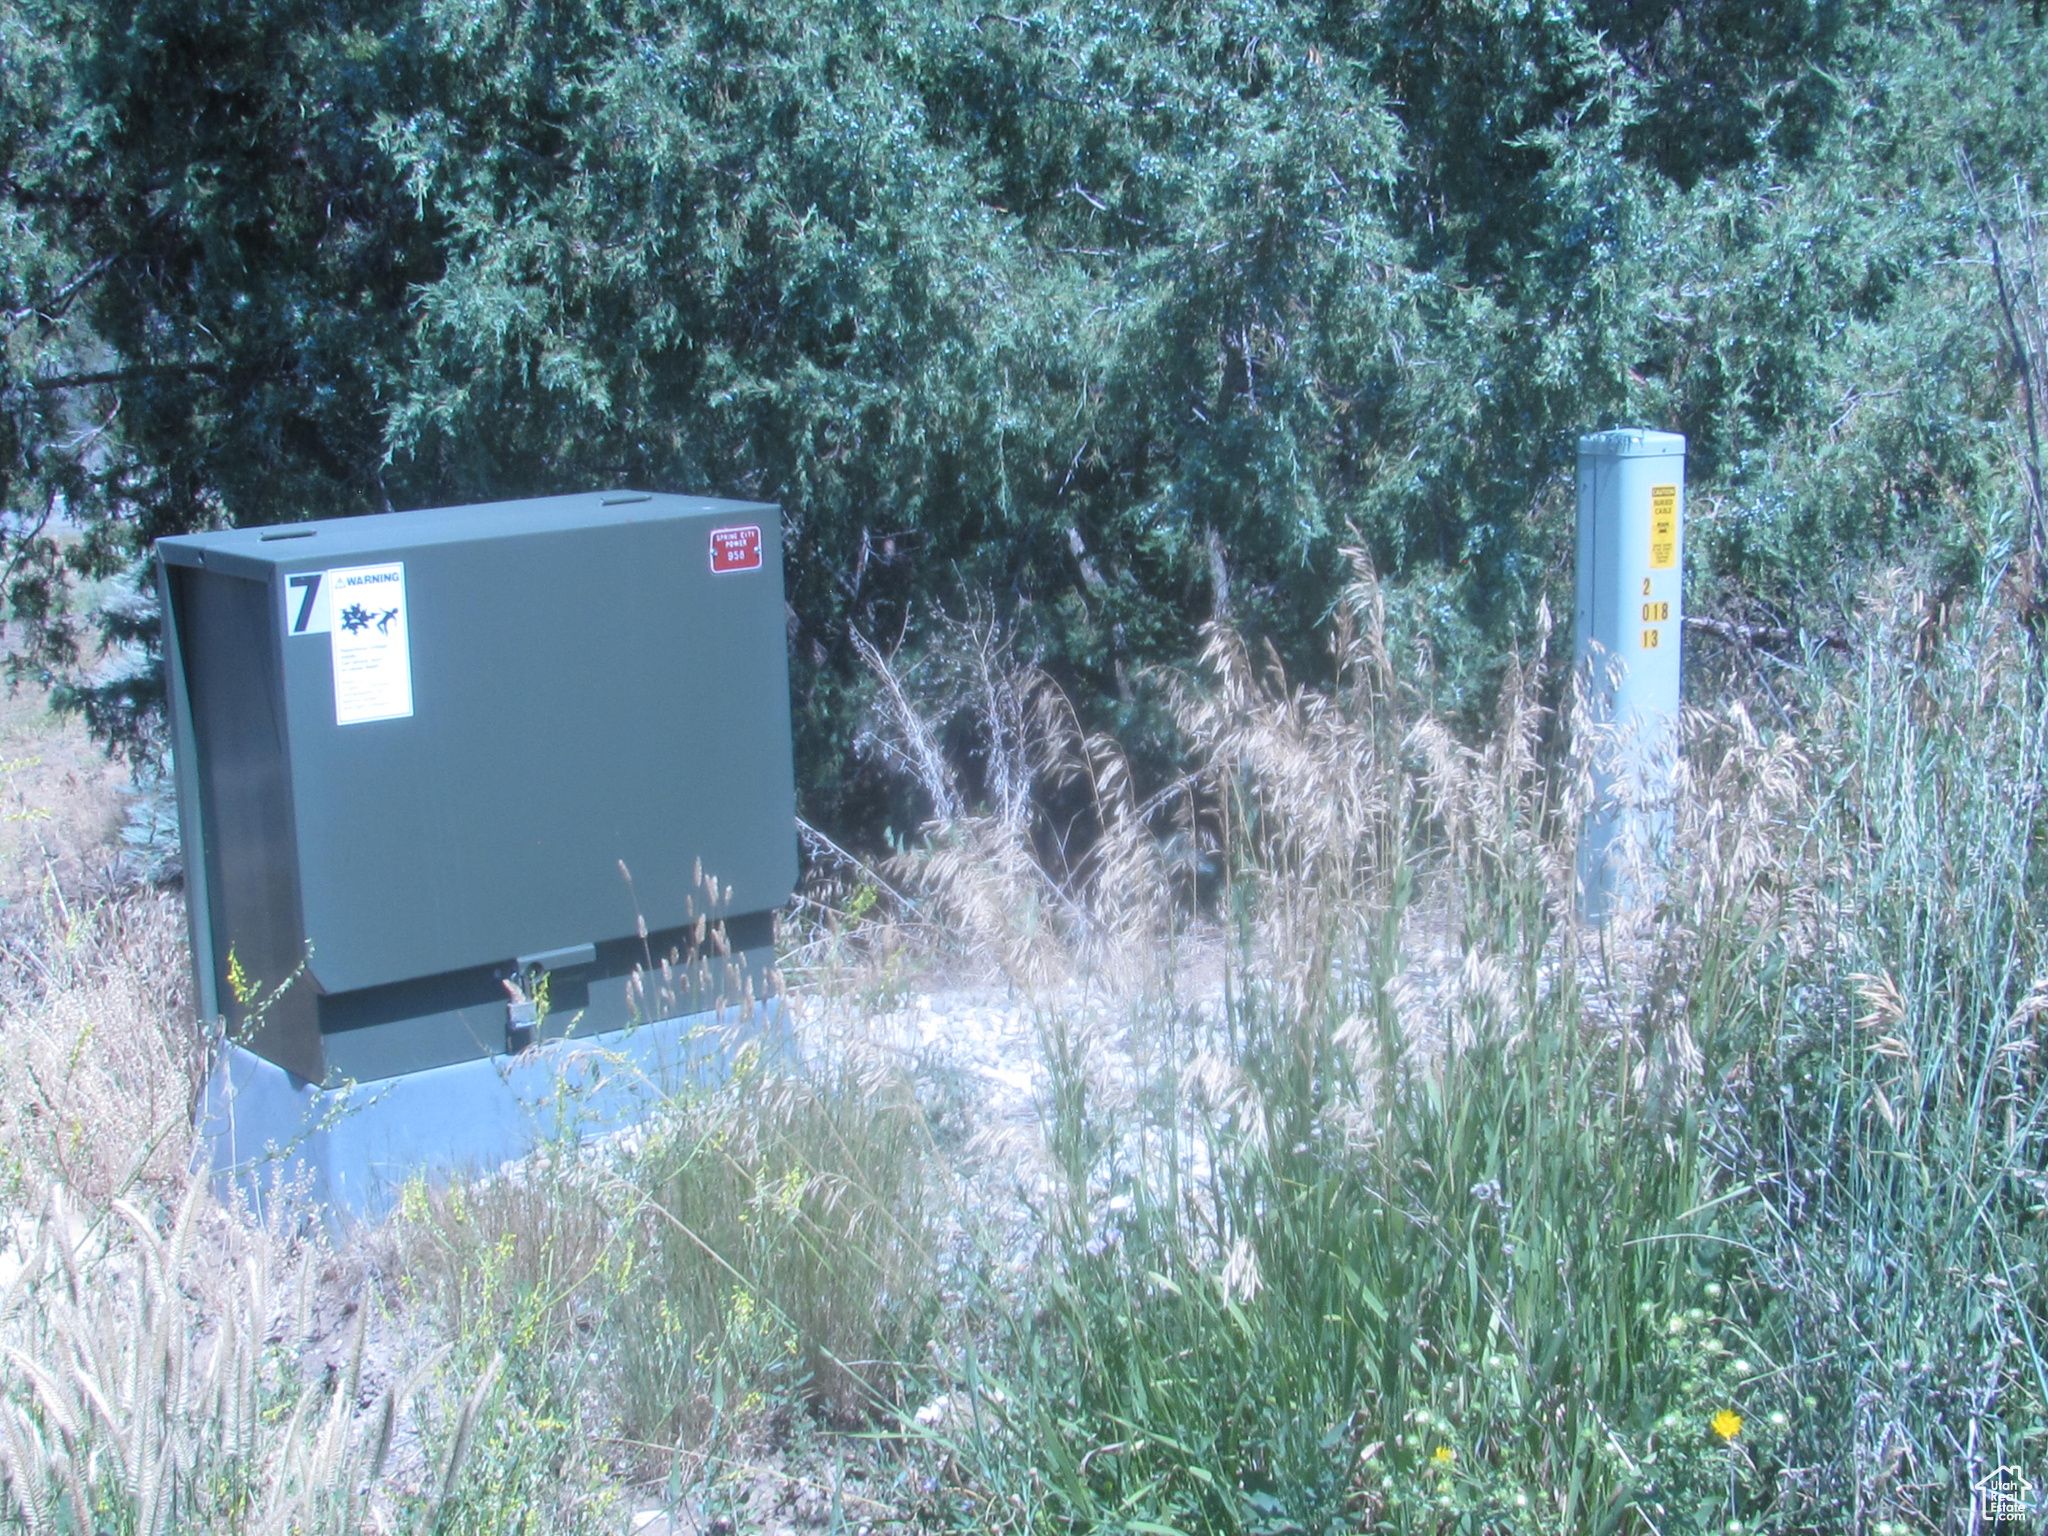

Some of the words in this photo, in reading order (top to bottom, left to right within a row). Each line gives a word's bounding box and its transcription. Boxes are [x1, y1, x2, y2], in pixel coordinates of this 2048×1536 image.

[716, 532, 738, 541] SPRING
[740, 530, 755, 539] CITY
[725, 538, 747, 548] POWER
[346, 572, 400, 586] WARNING
[1643, 577, 1650, 596] 2
[289, 573, 323, 633] 7
[1642, 602, 1669, 621] 018
[1643, 629, 1658, 648] 13
